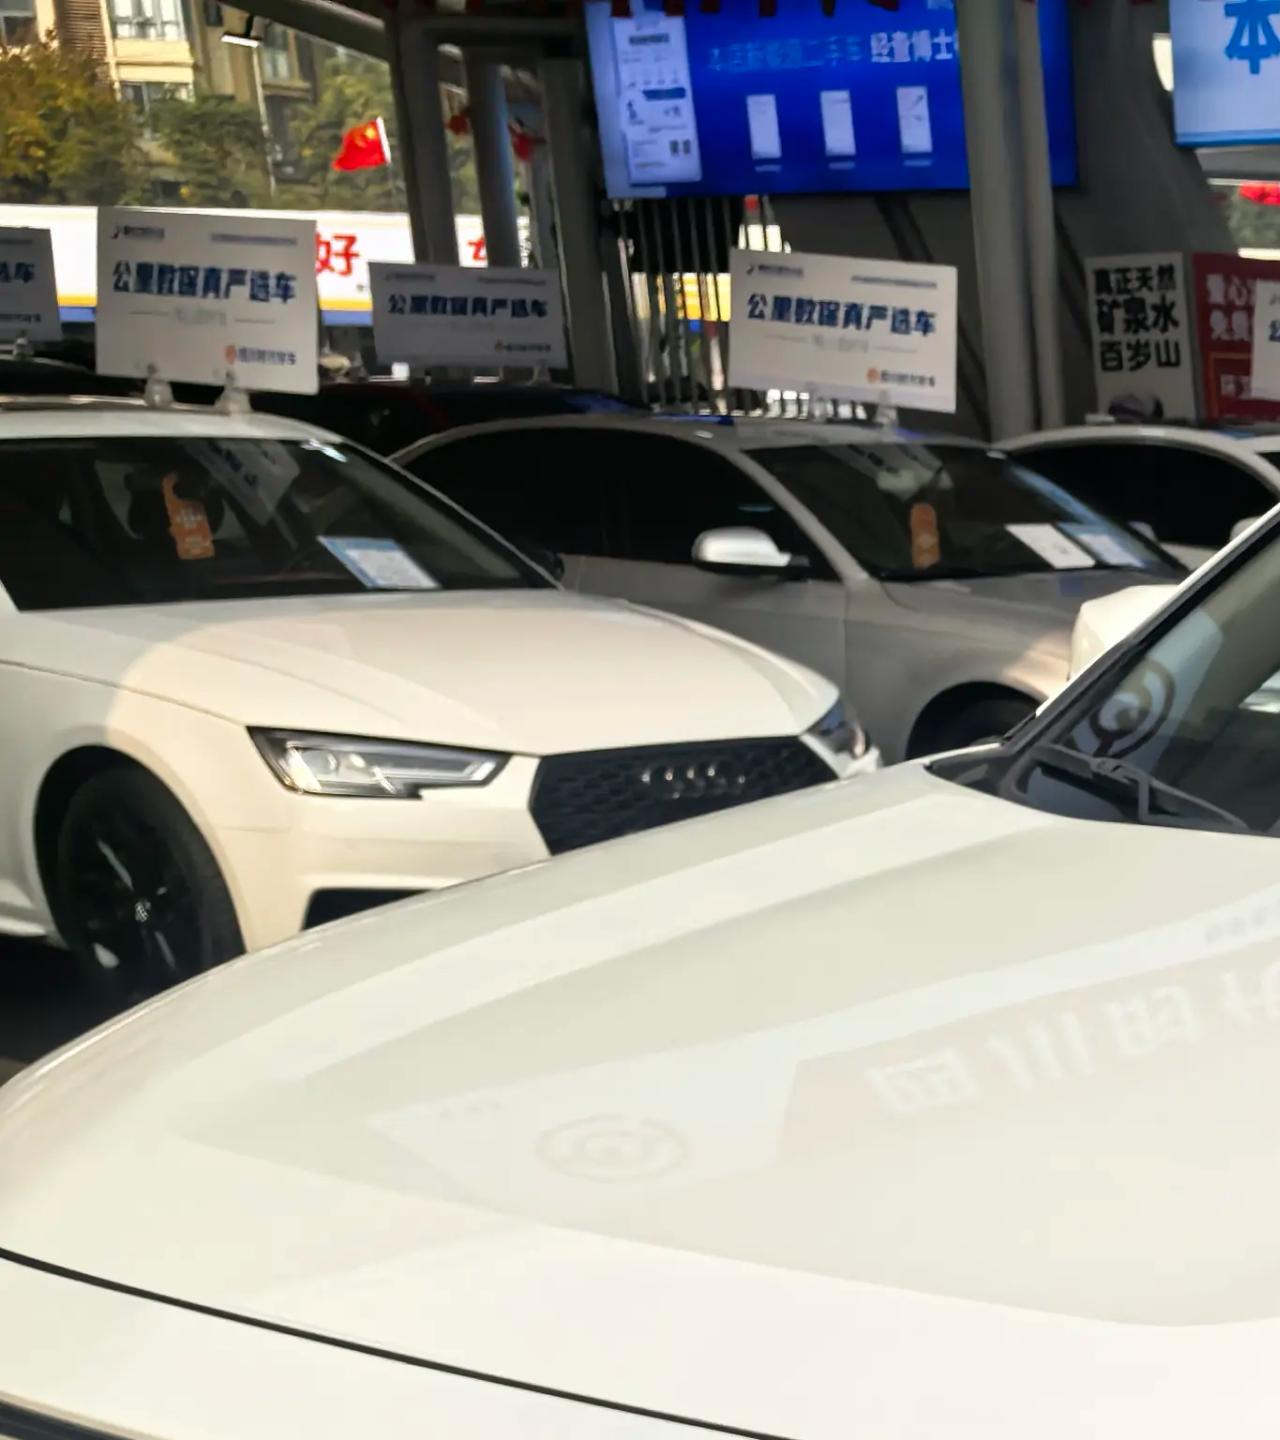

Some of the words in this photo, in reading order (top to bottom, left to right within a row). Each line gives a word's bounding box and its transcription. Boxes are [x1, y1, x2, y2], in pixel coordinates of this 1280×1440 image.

[1094, 264, 1175, 294] 真正天然
[1096, 295, 1179, 334] 矿泉水
[1099, 338, 1182, 371] 百岁山
